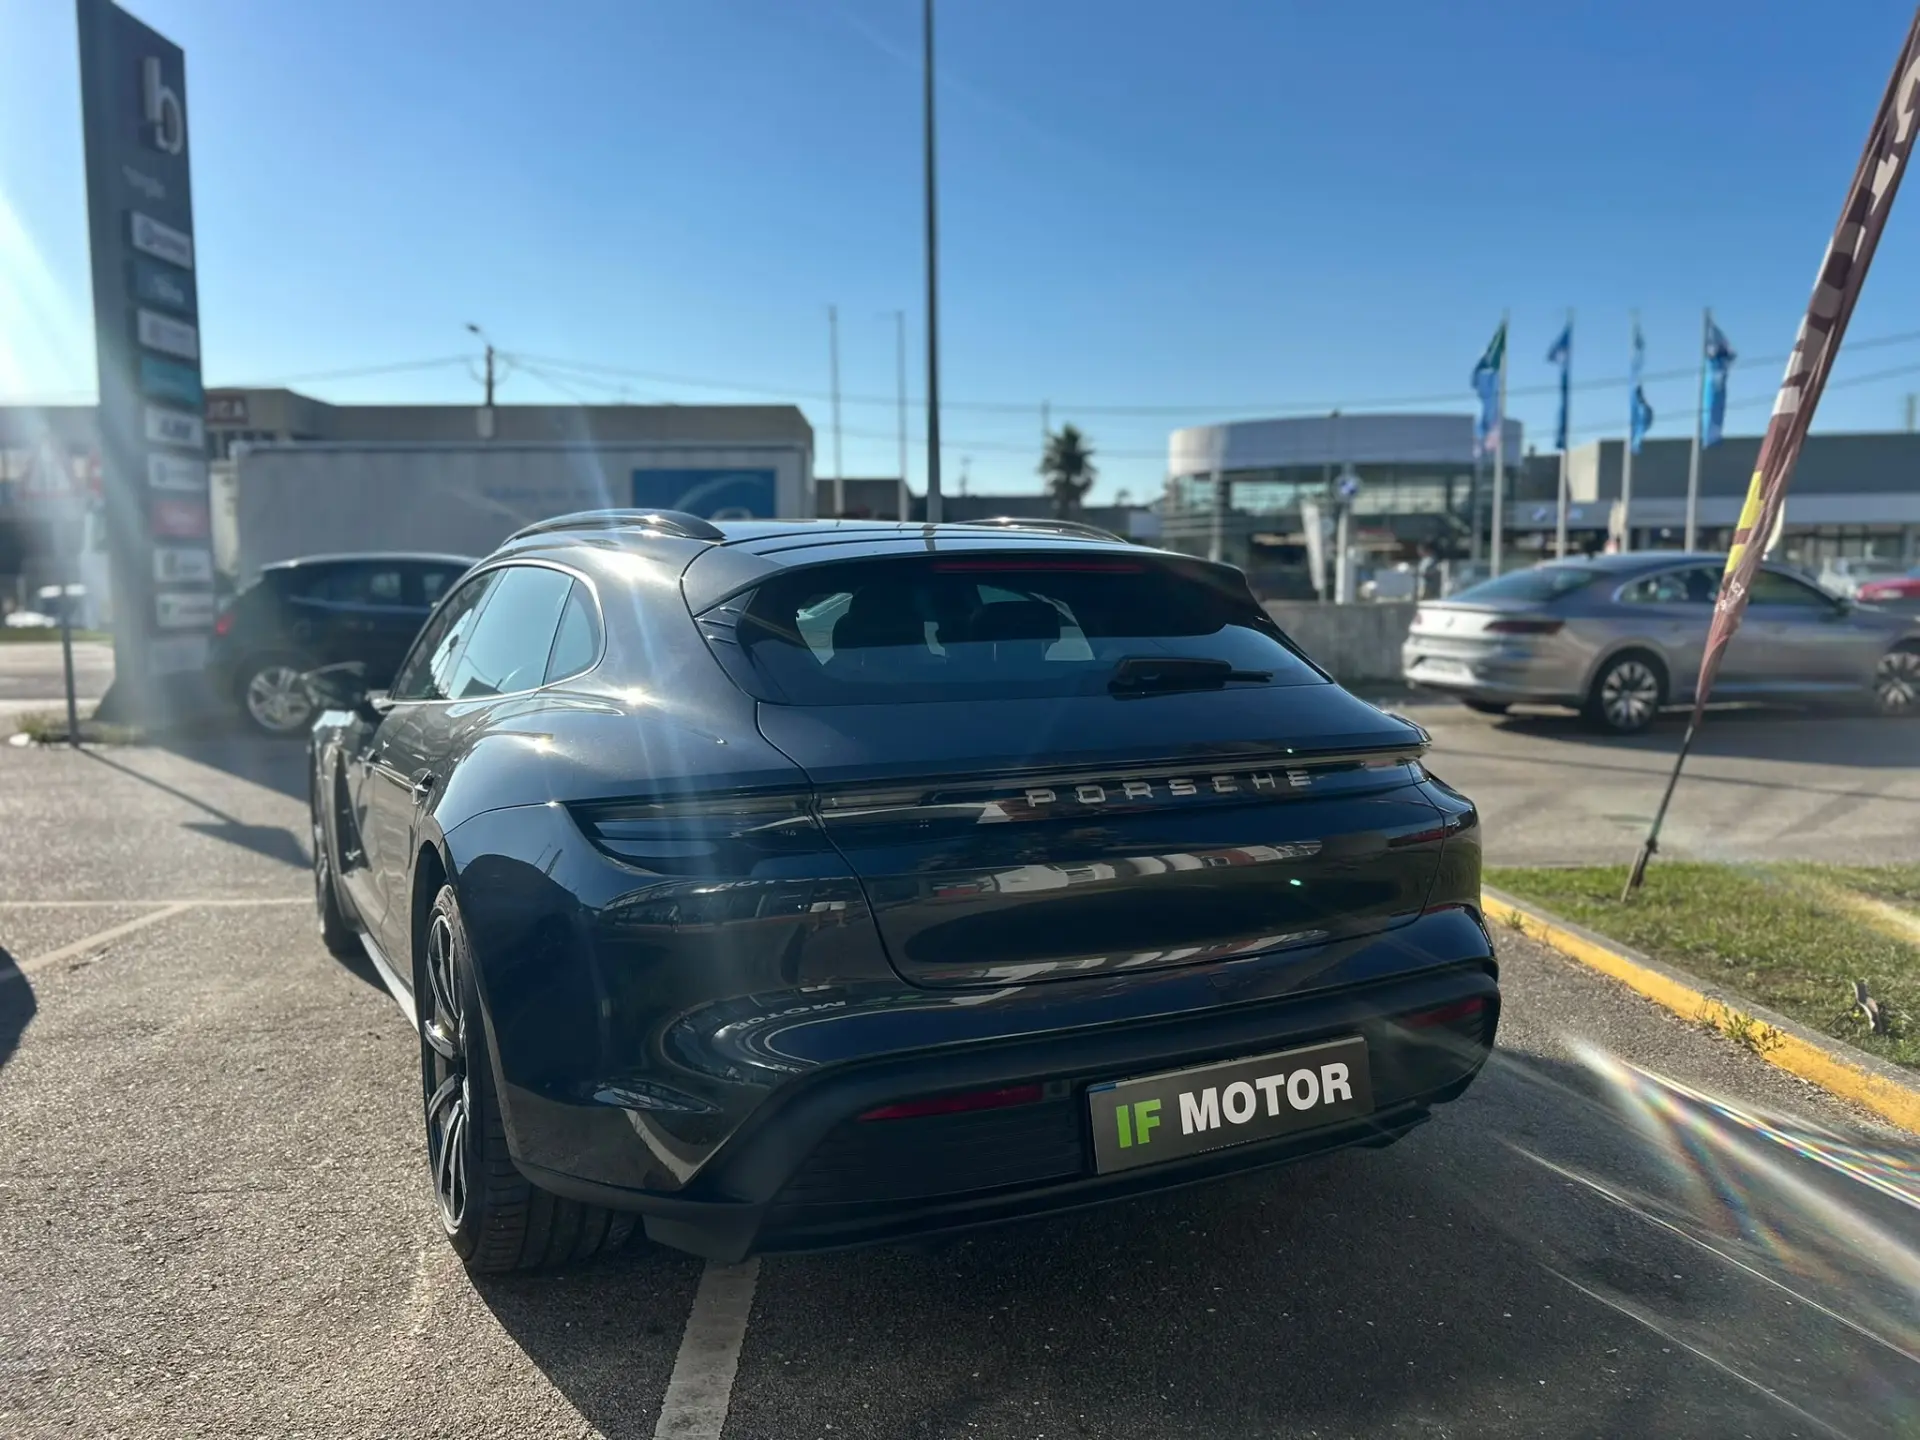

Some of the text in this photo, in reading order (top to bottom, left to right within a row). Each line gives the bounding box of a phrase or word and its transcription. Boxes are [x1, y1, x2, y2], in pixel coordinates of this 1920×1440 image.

[1024, 769, 1313, 808] PORSCHE
[1115, 1061, 1353, 1149] IF MOTOR
